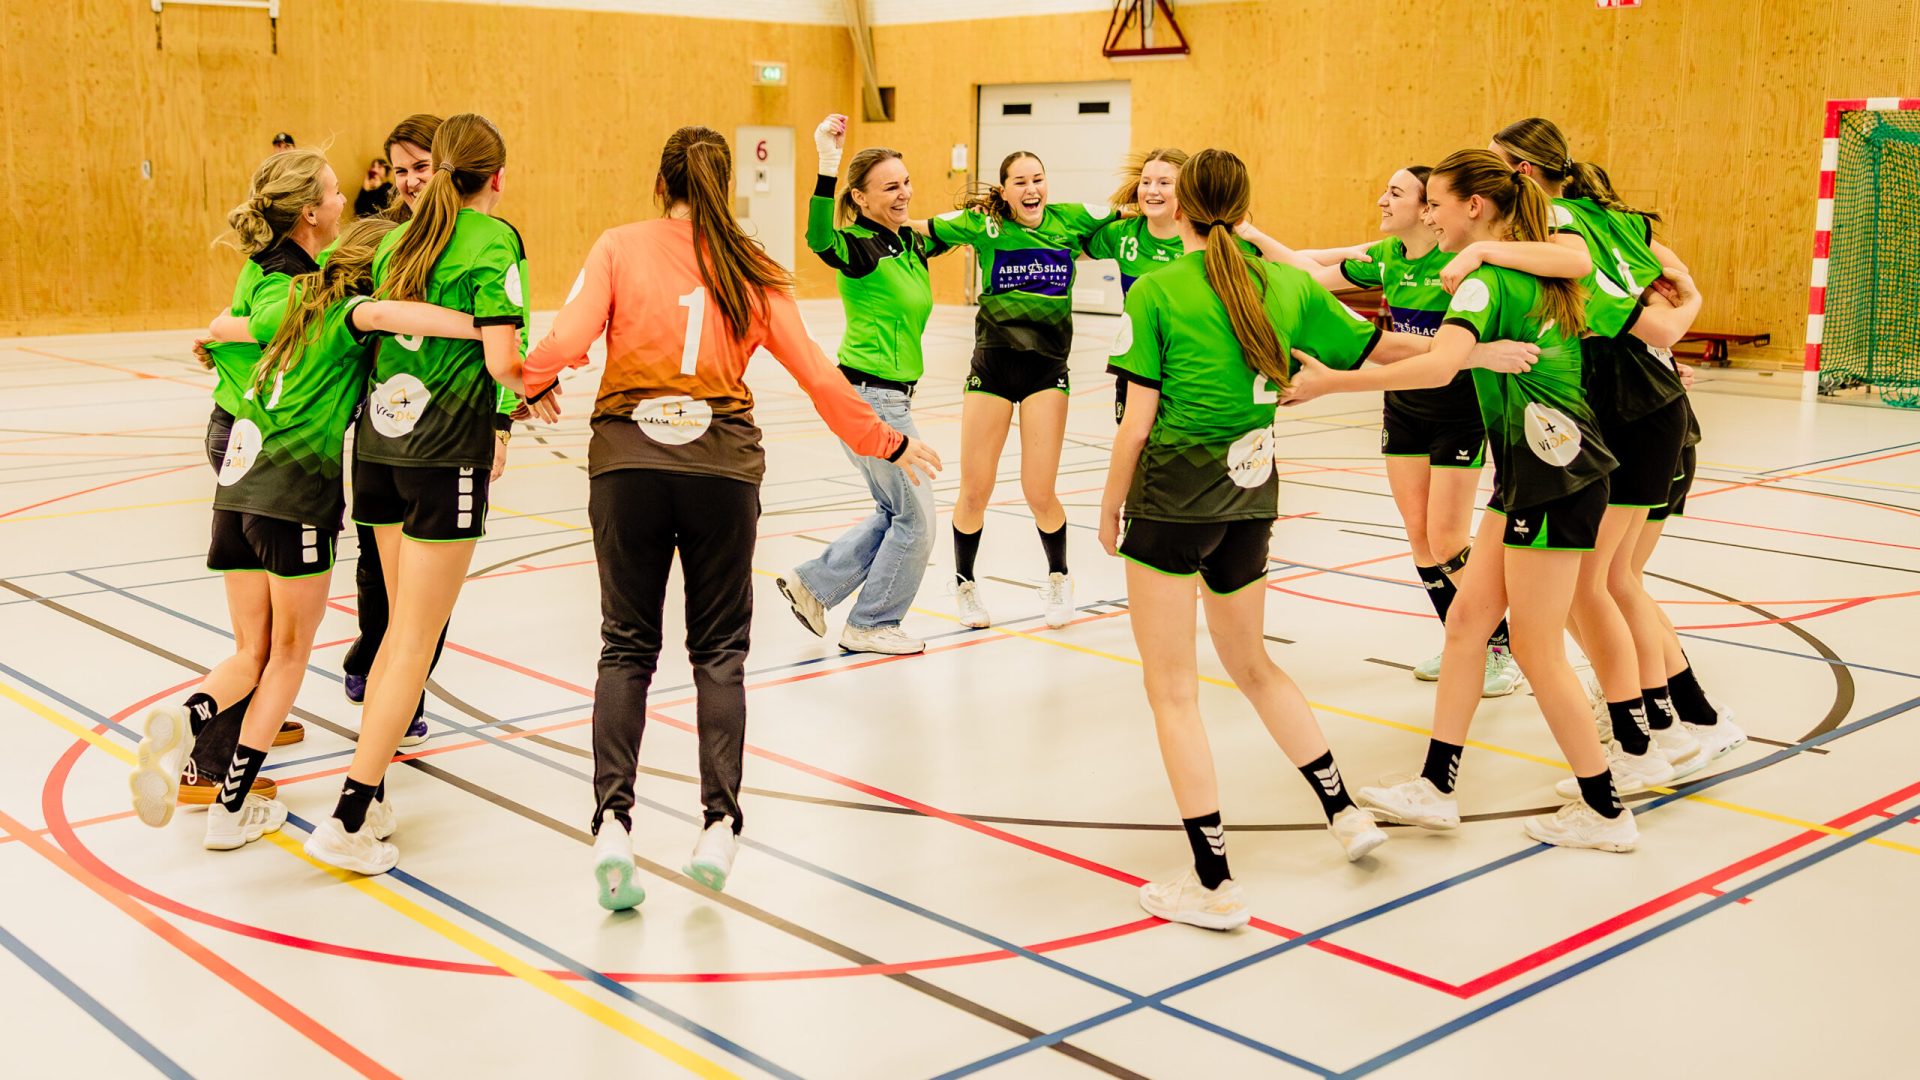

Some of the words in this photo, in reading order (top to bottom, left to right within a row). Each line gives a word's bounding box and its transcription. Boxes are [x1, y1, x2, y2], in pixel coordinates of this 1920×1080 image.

[757, 141, 767, 160] 6
[985, 216, 999, 238] 6
[1120, 236, 1139, 261] 13
[999, 265, 1026, 274] ABEN
[1044, 264, 1067, 273] SLAG
[679, 287, 705, 376] 1
